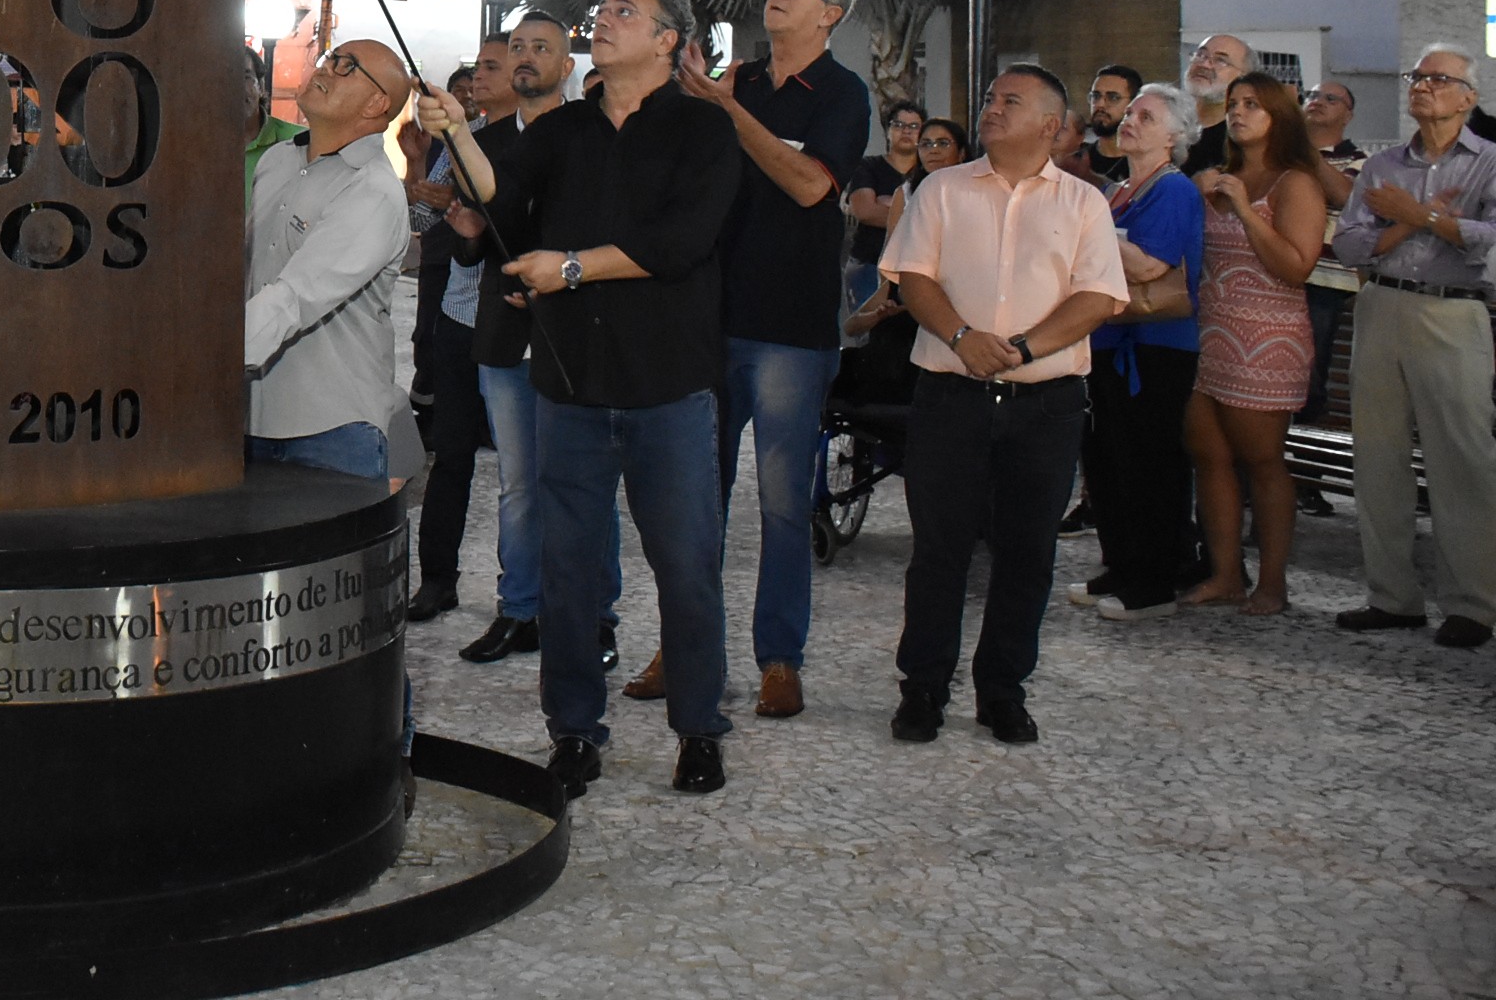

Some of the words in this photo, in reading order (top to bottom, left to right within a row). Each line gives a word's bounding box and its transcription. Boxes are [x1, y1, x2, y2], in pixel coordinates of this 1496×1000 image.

[8, 388, 142, 445] 2010
[296, 575, 327, 613] de
[333, 567, 363, 604] Itu
[154, 658, 173, 686] e
[182, 637, 312, 683] conforto
[318, 632, 333, 658] a
